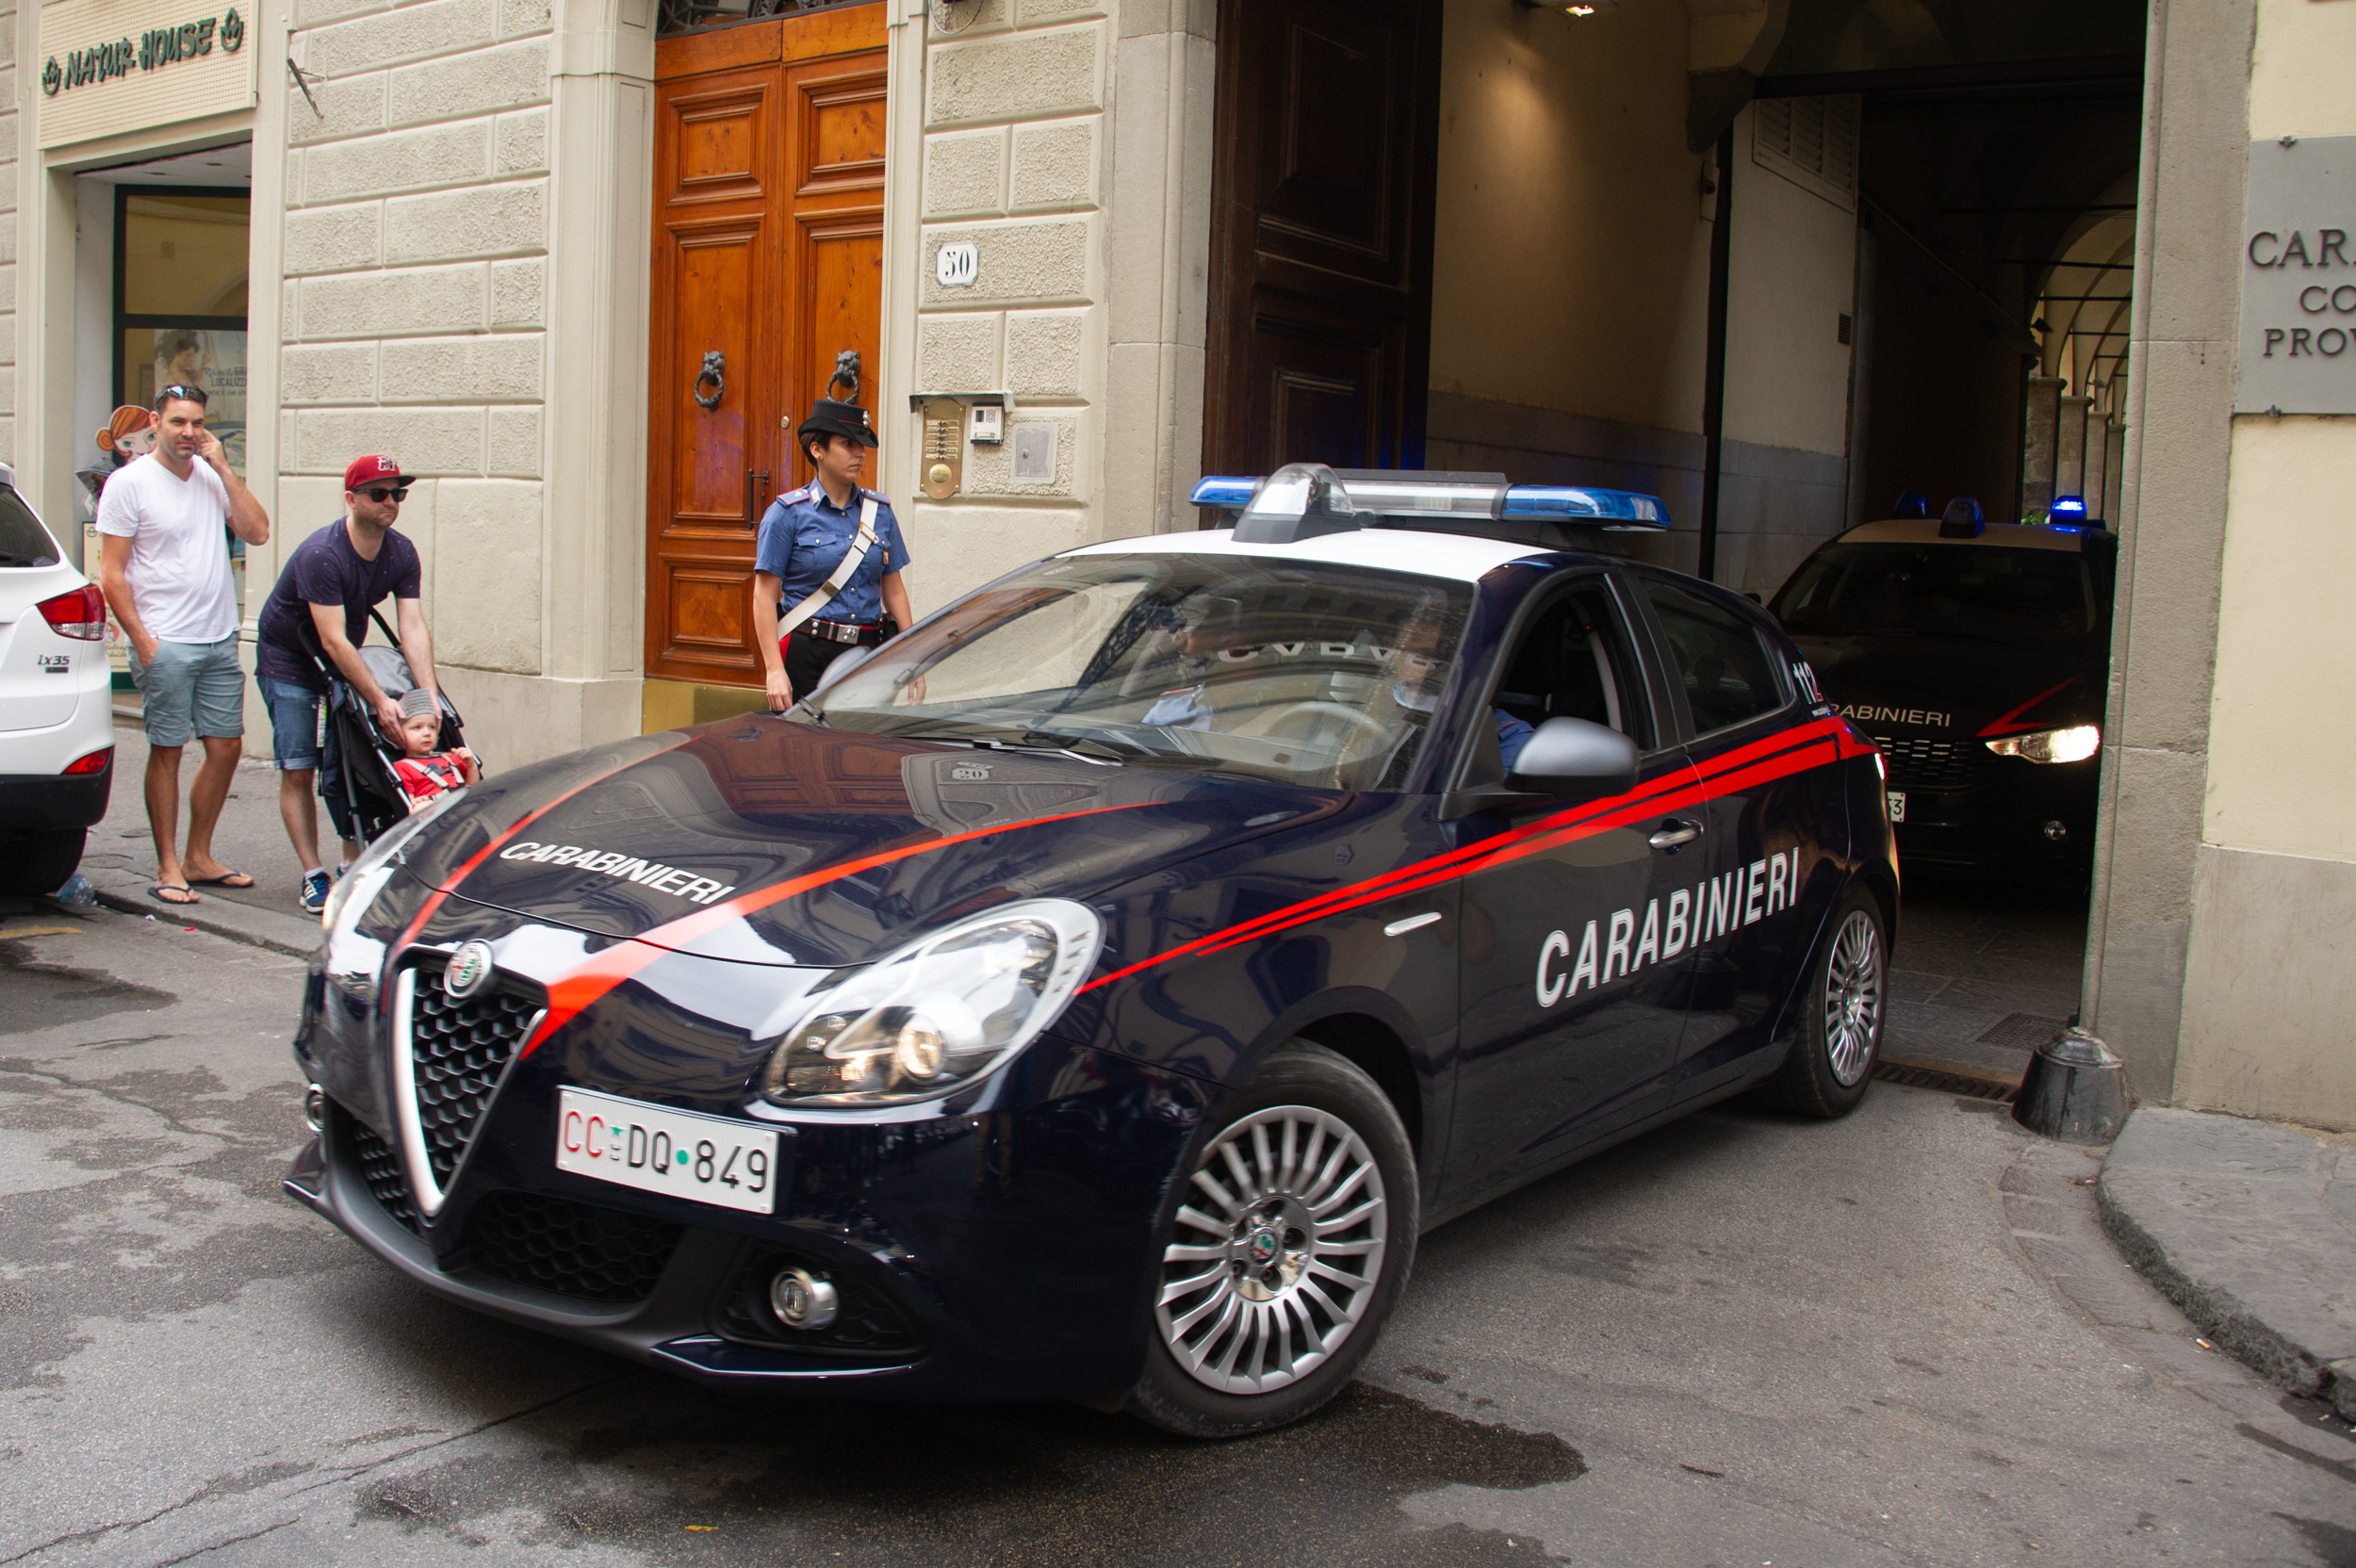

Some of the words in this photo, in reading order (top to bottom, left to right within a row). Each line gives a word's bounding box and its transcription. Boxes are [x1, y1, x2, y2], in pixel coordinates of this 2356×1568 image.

[64, 37, 136, 90] NATUR
[139, 17, 217, 71] HOUSE
[945, 250, 970, 278] 50
[2249, 229, 2356, 268] CAR
[2299, 285, 2356, 313] CO
[1829, 703, 1951, 727] ABINIERI
[499, 841, 736, 905] CARABINIERI
[1536, 847, 1799, 1008] CARABINIERI
[564, 1110, 605, 1158] CC
[628, 1123, 672, 1176] DQ
[695, 1139, 768, 1193] 849
